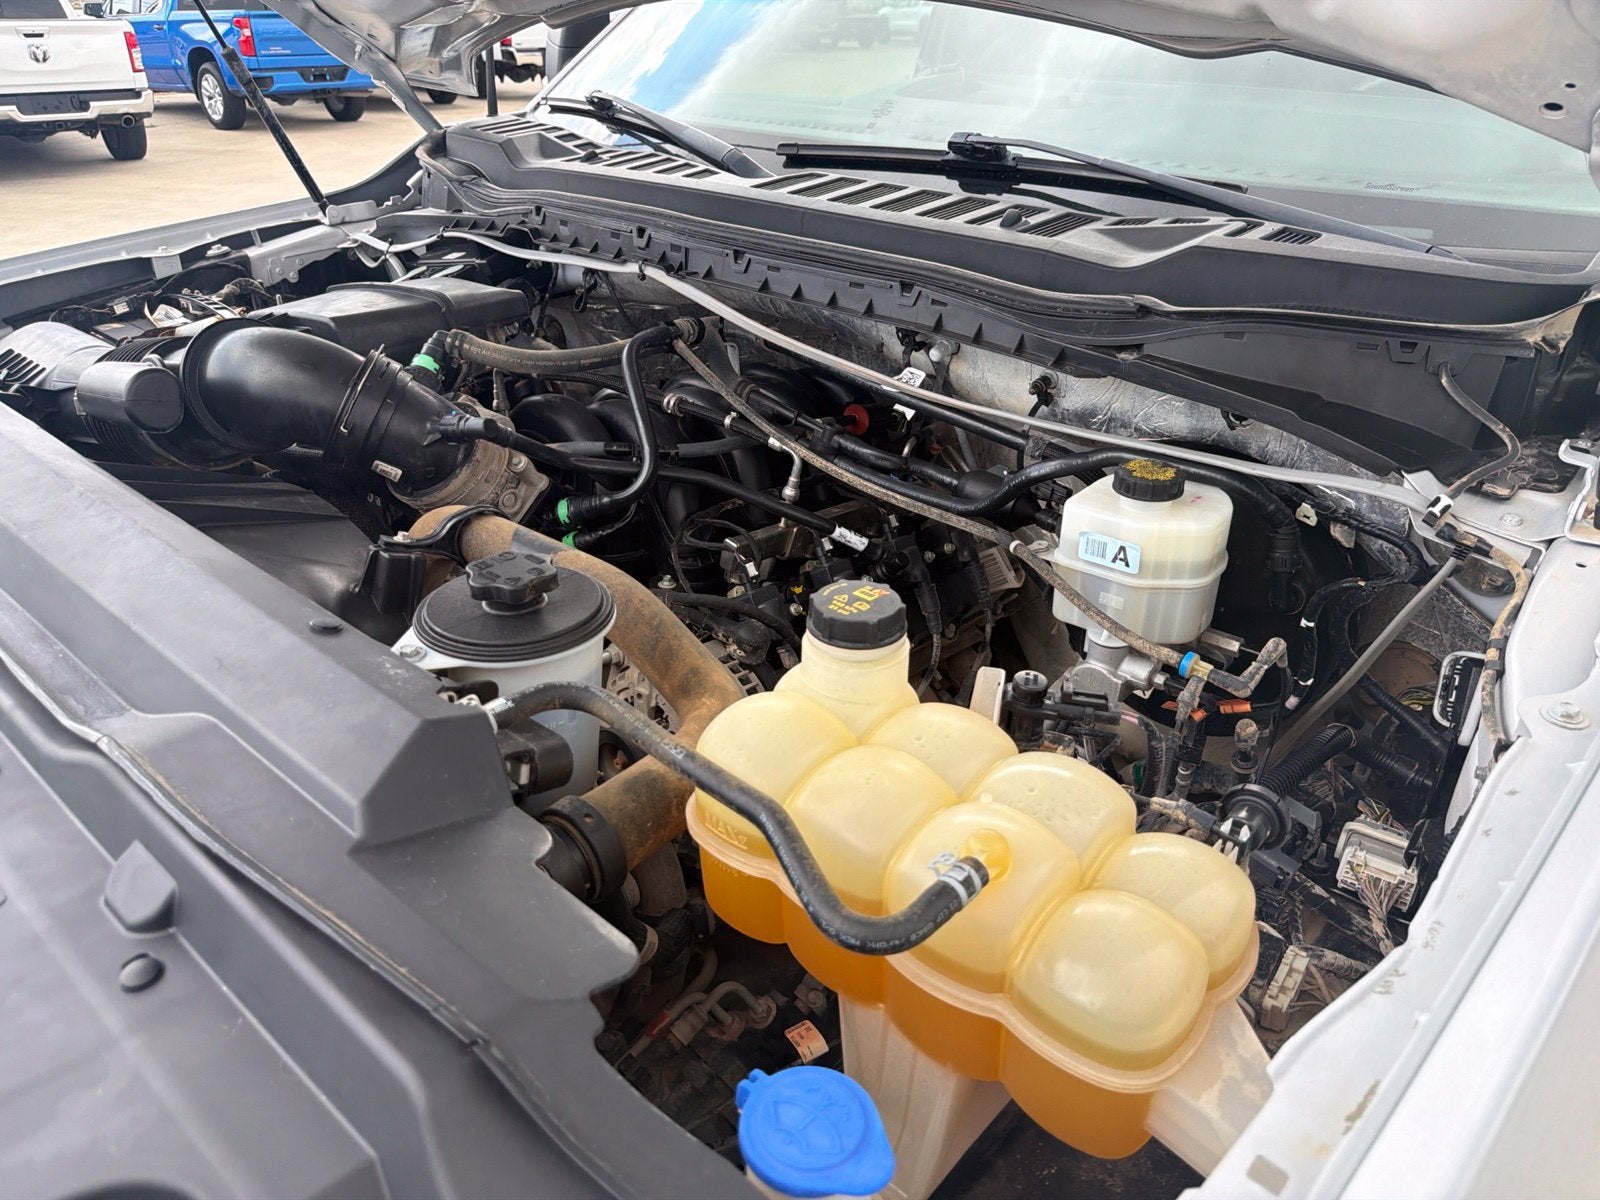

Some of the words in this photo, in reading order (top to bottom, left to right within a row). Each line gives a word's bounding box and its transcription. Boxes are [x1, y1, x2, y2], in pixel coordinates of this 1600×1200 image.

[1364, 182, 1414, 192] SoundScreen
[1111, 545, 1130, 568] A
[704, 812, 739, 845] MAX
